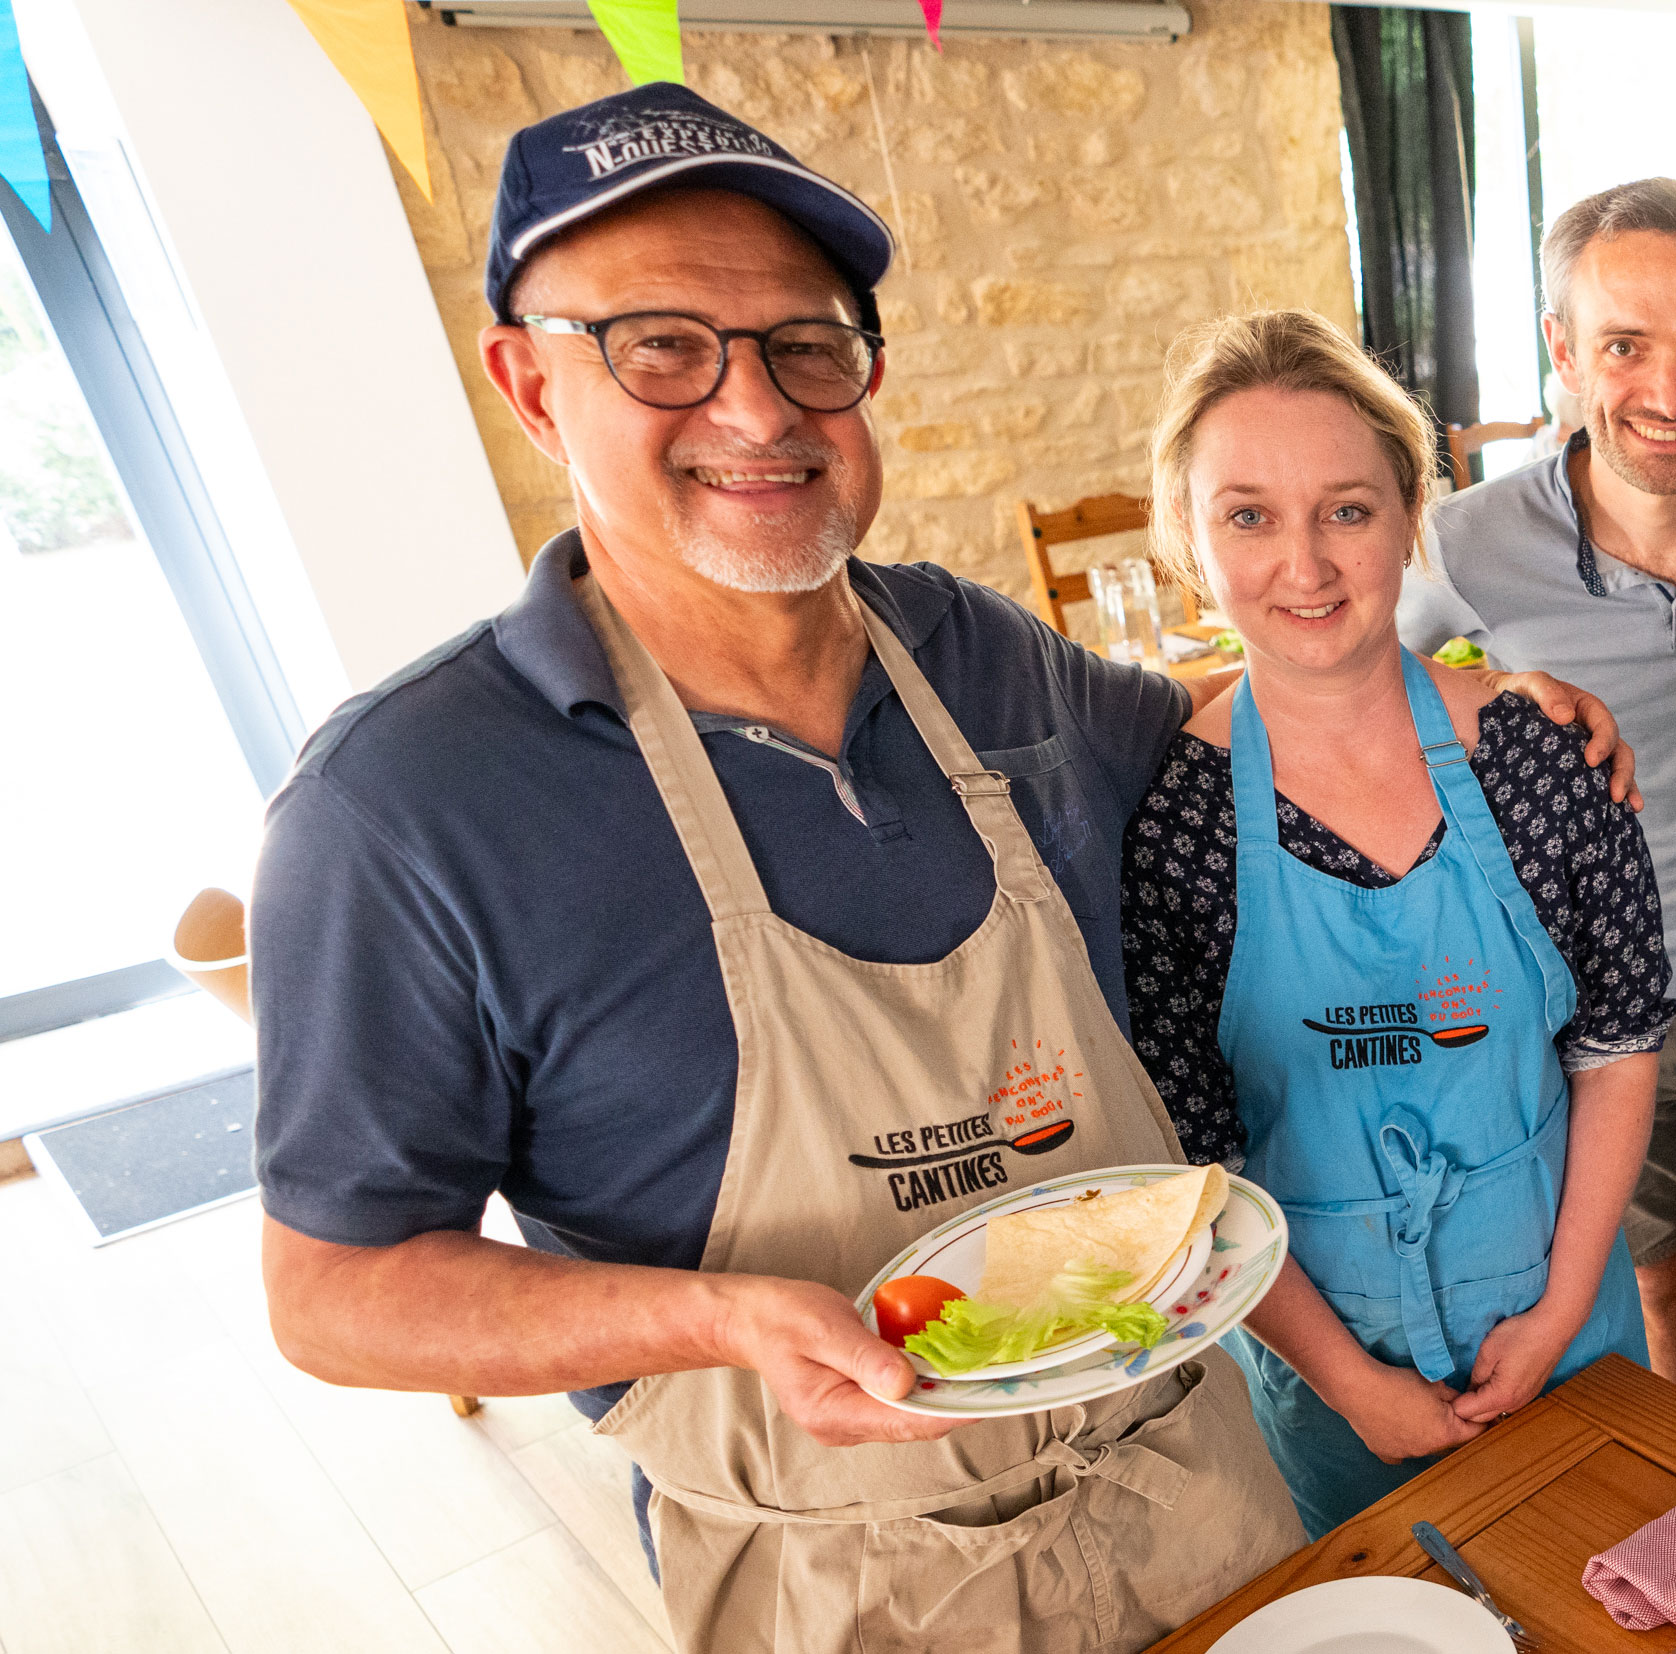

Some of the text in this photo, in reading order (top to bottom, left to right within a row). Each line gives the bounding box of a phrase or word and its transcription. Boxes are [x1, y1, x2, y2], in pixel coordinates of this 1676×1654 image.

[1437, 973, 1459, 986] LES
[1441, 998, 1467, 1010] ONT
[1325, 1003, 1419, 1026] LES PETITES
[1429, 1012, 1446, 1022] DU
[1330, 1034, 1422, 1070] CANTINES
[1006, 1062, 1031, 1080] LES
[1016, 1091, 1044, 1108] ONT
[1005, 1114, 1025, 1126] DU
[874, 1112, 994, 1155] LES PETITES
[887, 1151, 1009, 1212] CANTINES
